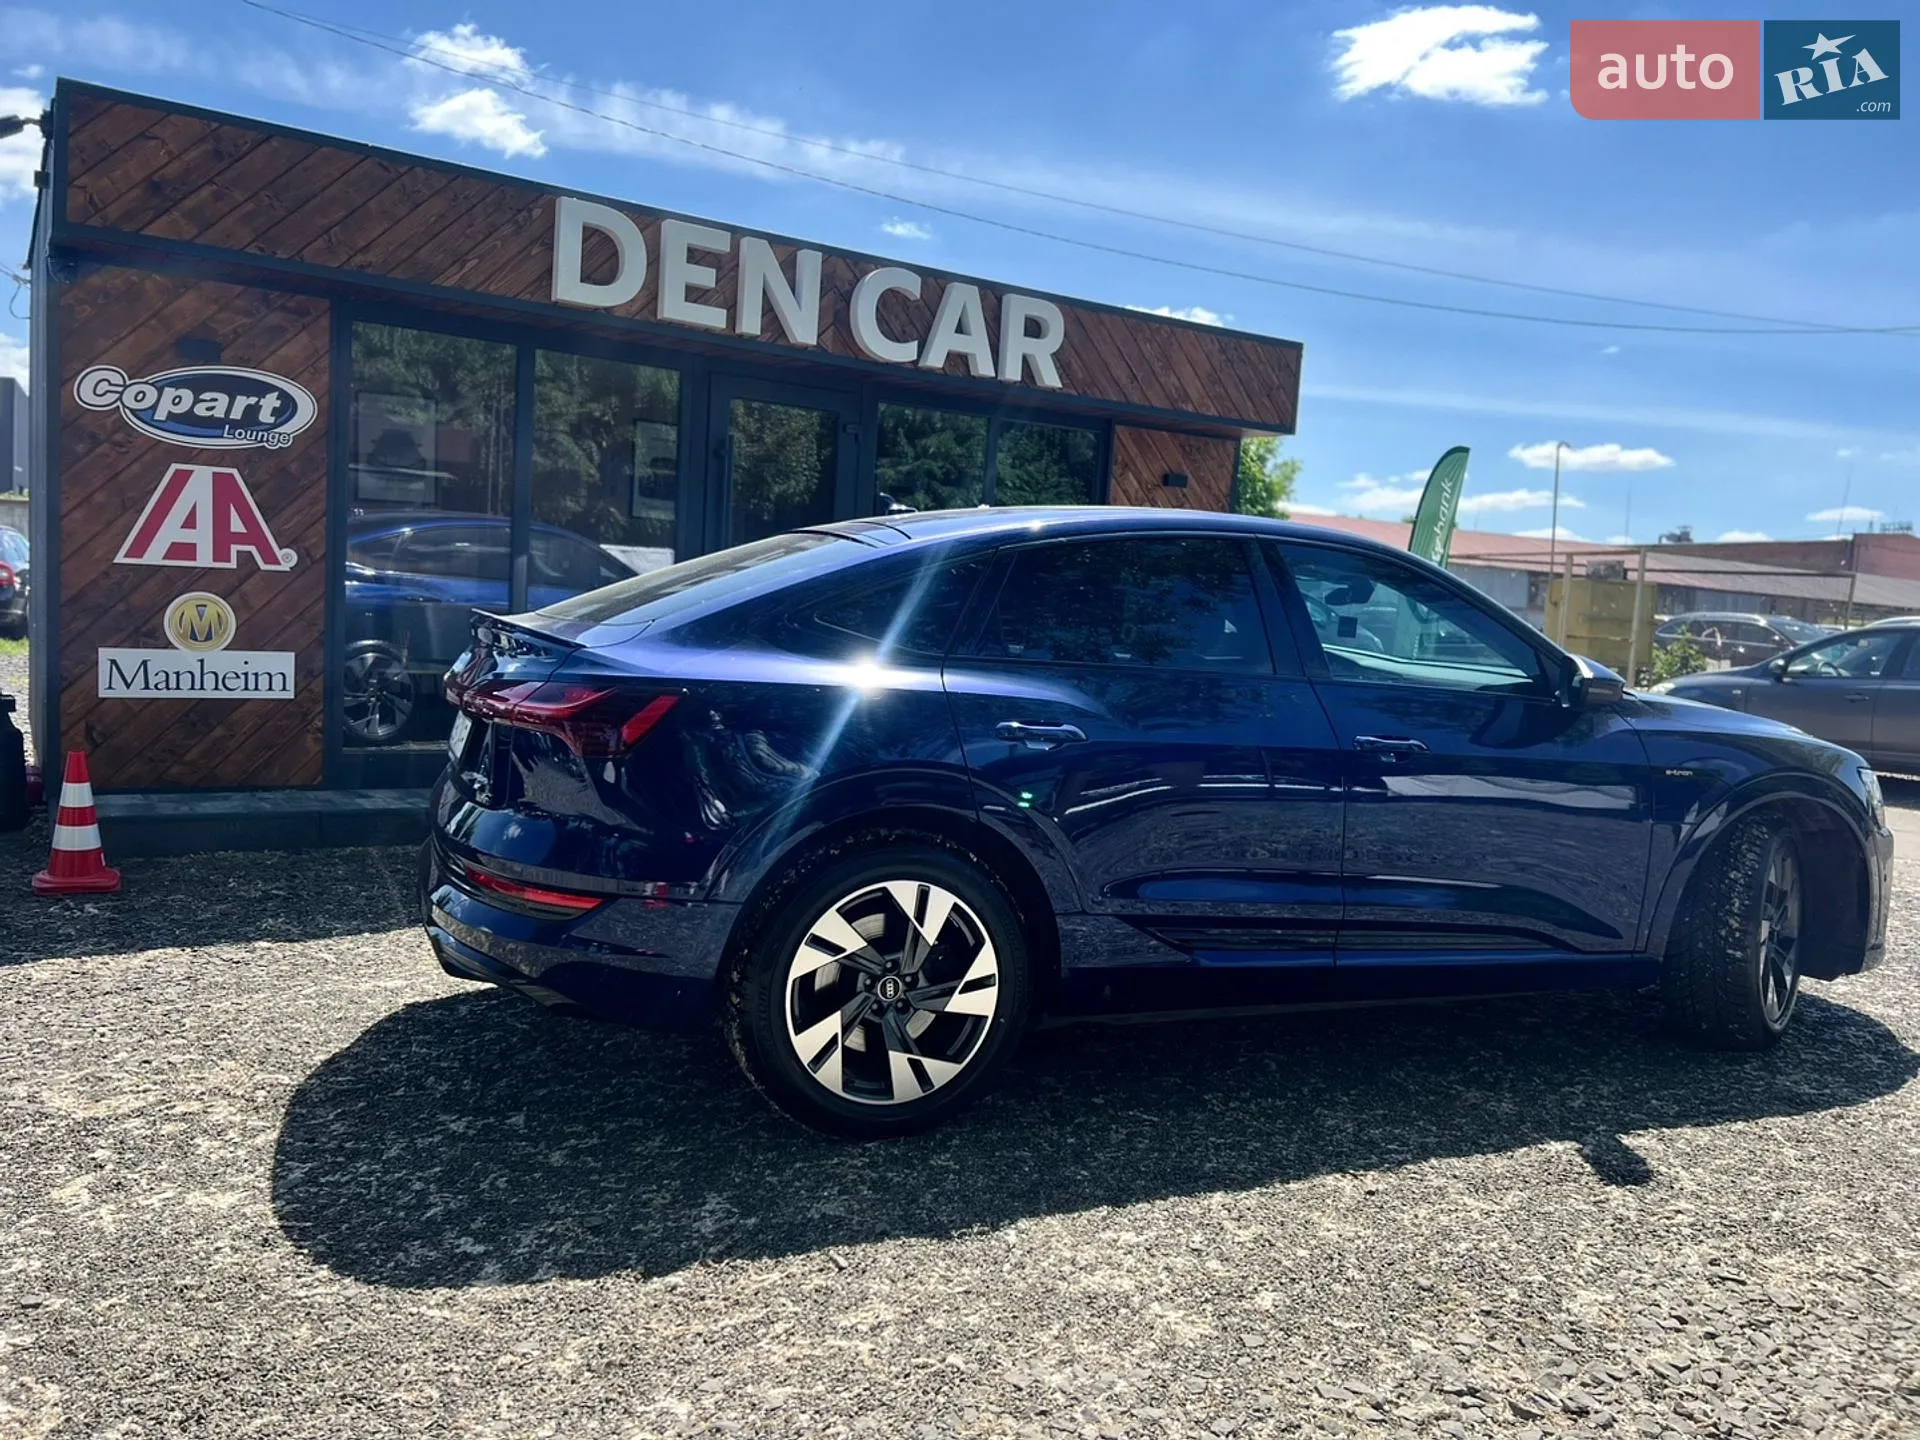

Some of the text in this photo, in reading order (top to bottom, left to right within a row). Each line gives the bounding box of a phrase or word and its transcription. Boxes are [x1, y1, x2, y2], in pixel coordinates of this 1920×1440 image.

[551, 196, 1065, 389] DEN CAR
[77, 367, 282, 425] Copart
[223, 424, 290, 446] Lounge
[103, 658, 292, 693] Manheim
